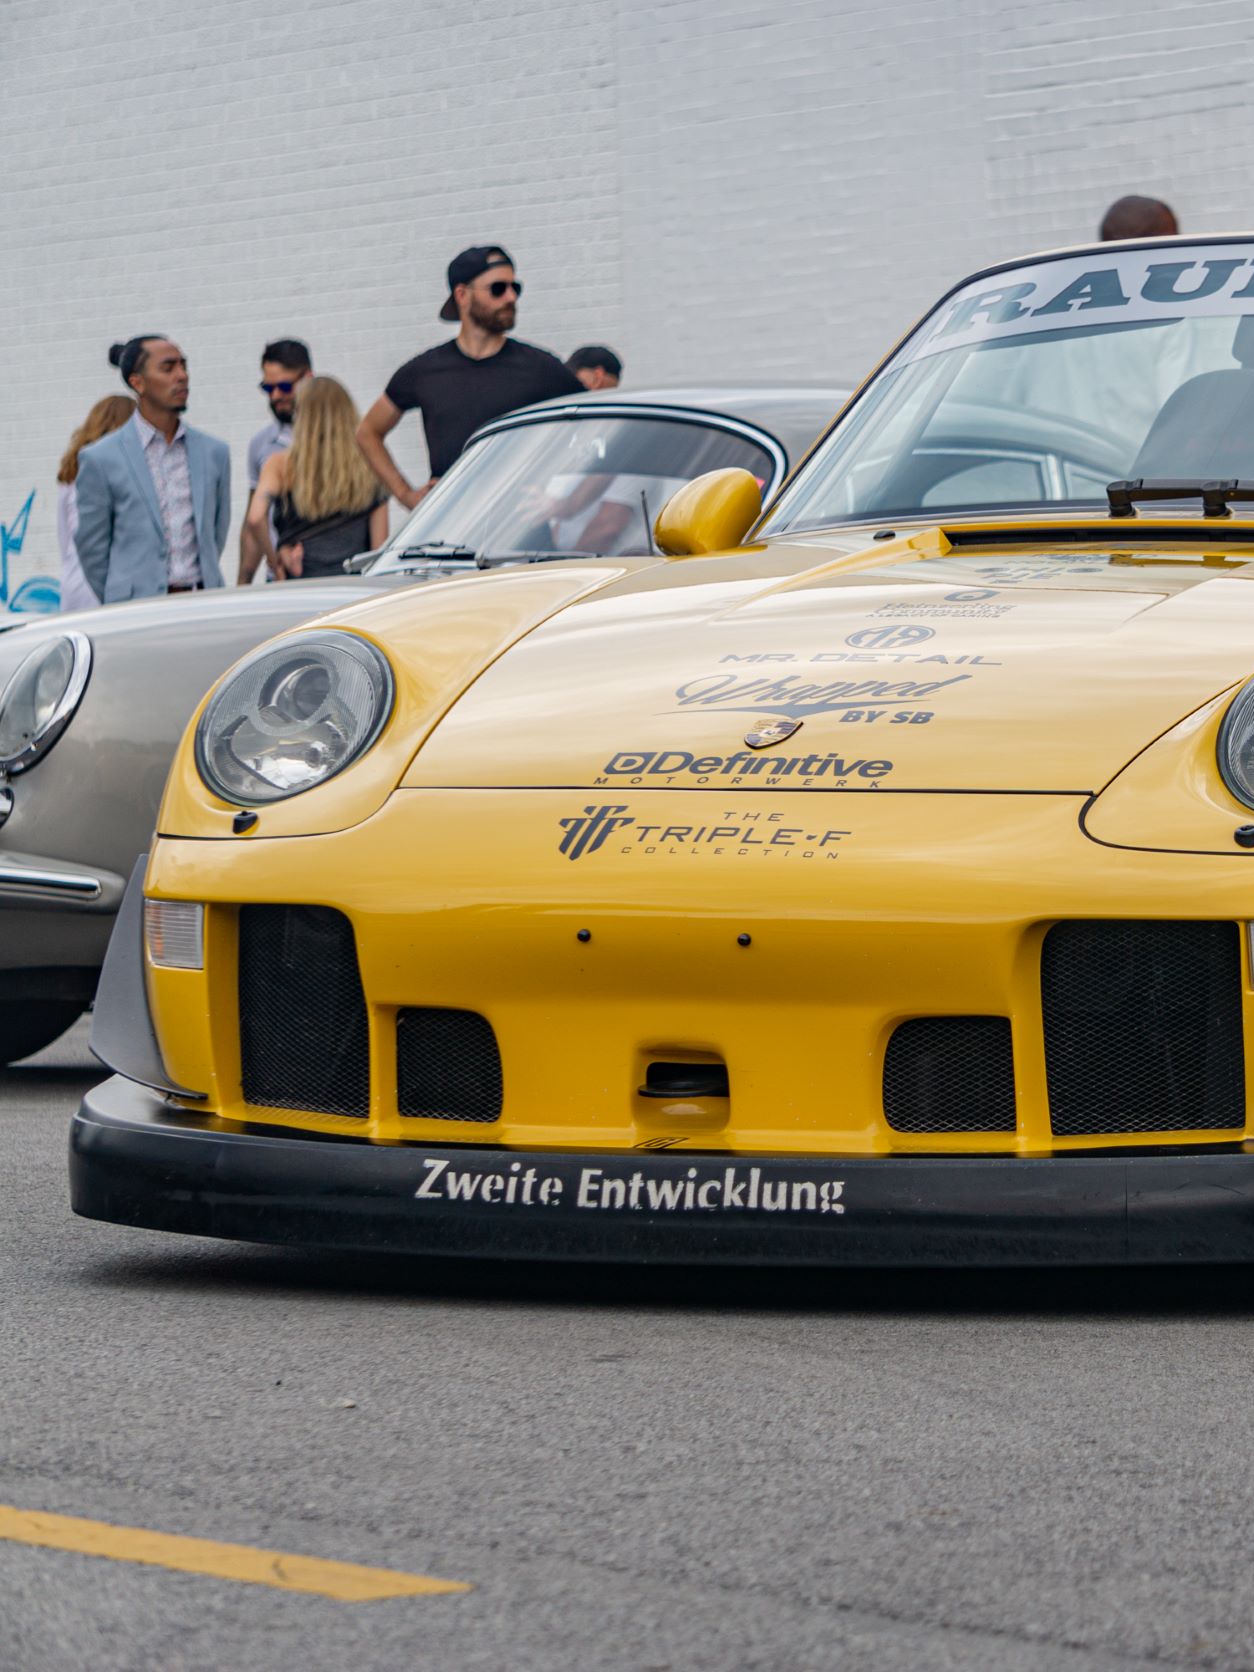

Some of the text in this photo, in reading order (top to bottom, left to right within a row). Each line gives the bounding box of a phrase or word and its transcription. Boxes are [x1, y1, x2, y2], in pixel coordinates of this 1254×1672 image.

[718, 652, 1003, 665] MR. DETAIL
[675, 673, 974, 706] Wrapped
[839, 710, 936, 725] BY SB
[645, 751, 895, 779] Definitive
[593, 776, 882, 788] MOTORWERK
[722, 812, 785, 822] THE
[620, 846, 839, 860] COLLECTION
[414, 1158, 846, 1215] Zweite Entwicklung
